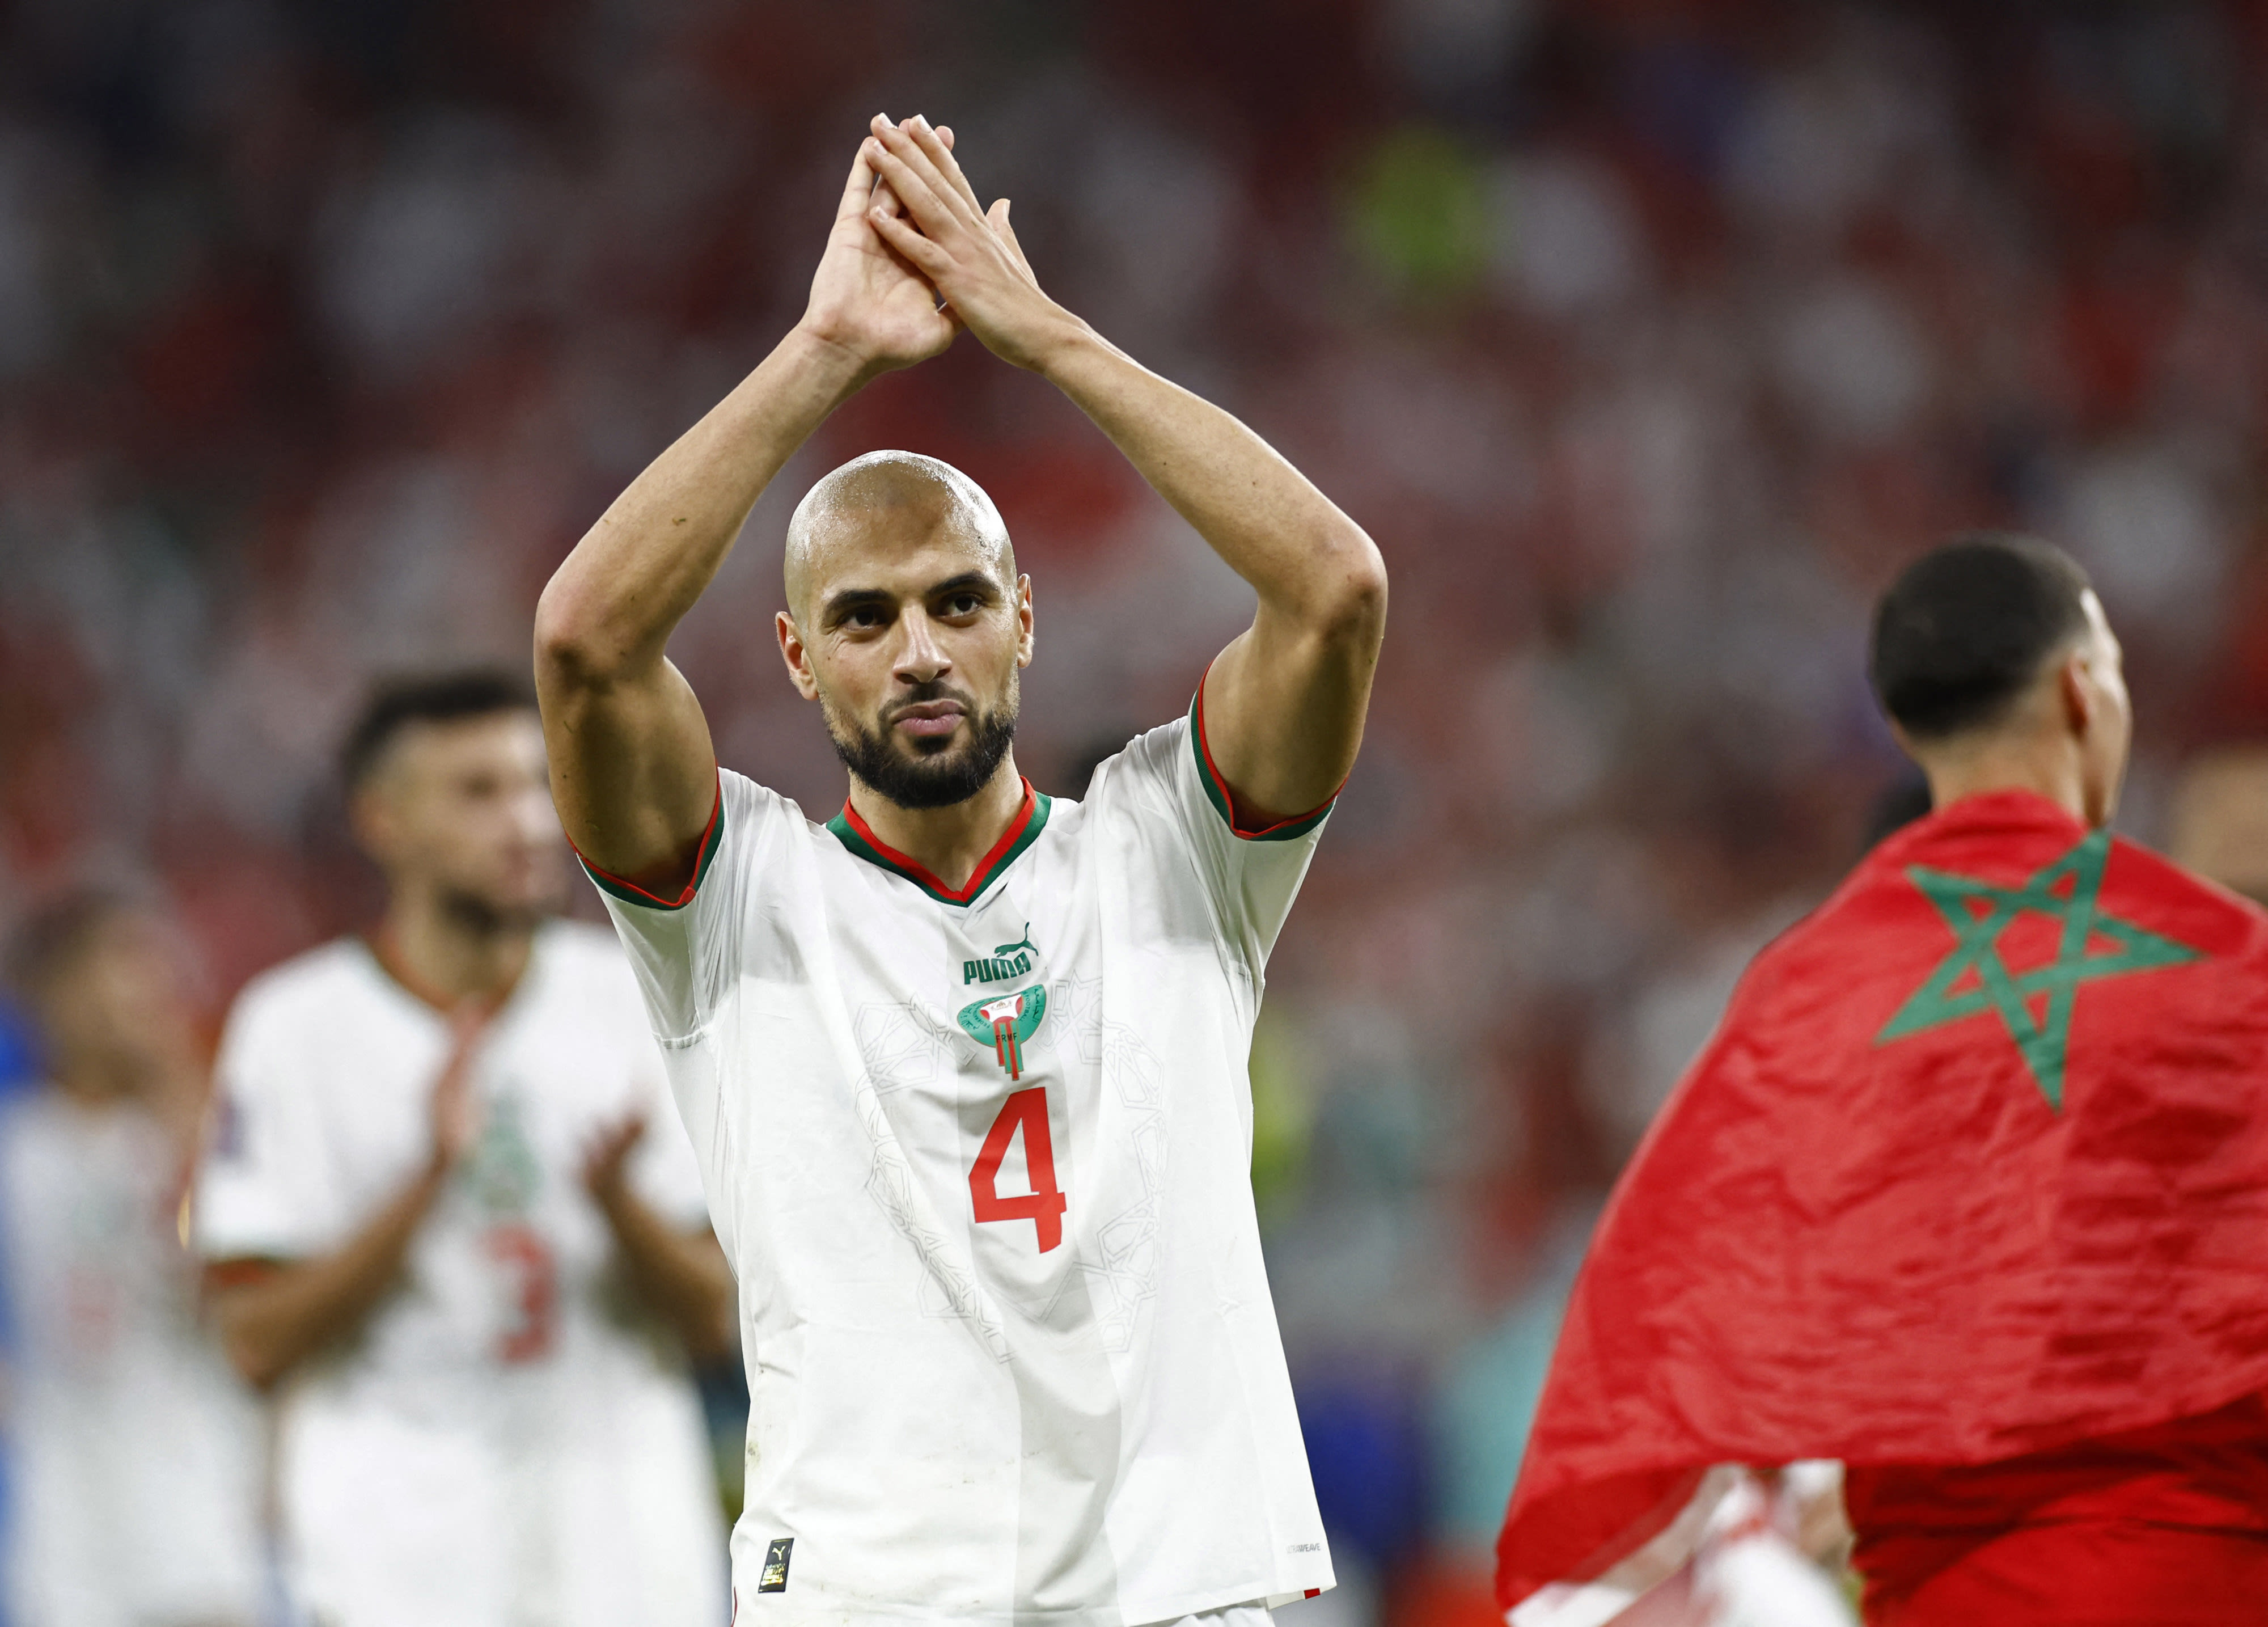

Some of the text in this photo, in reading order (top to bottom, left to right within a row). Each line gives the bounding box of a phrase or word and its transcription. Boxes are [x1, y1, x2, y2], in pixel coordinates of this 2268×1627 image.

[963, 952, 1031, 984] PUMA
[996, 1032, 1017, 1044] FRMF
[968, 1087, 1067, 1254] 4
